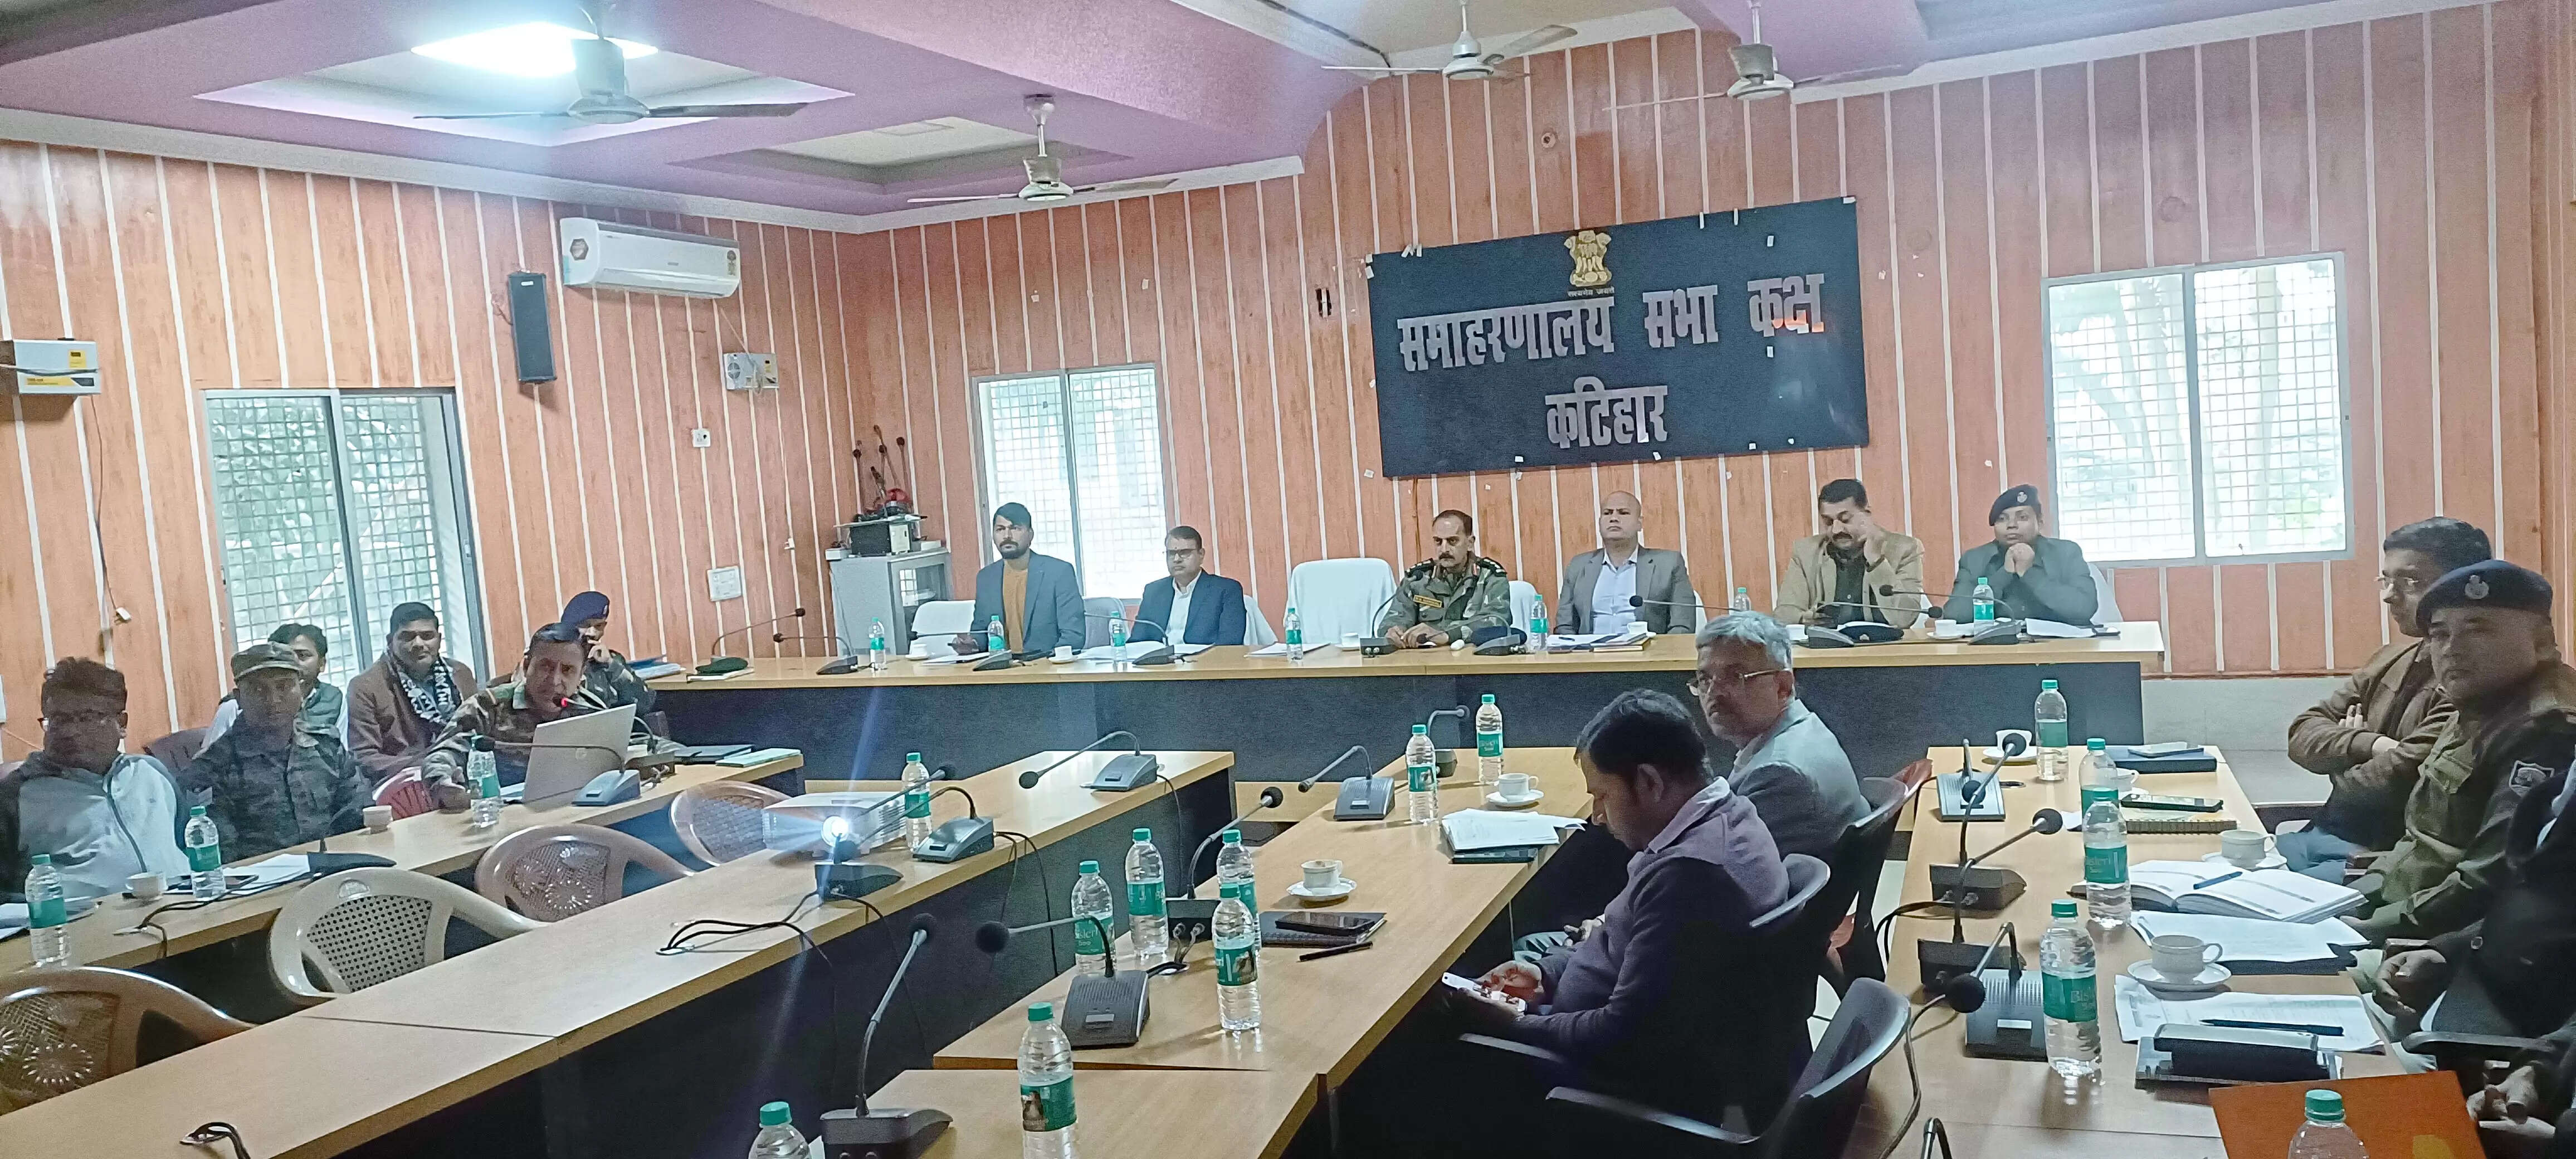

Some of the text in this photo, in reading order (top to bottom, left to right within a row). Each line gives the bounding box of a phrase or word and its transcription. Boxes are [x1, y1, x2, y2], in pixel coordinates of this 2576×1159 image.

[1397, 273, 1824, 372] समाहरणालय सभा कक्ष
[1545, 376, 1668, 449] कटिहार
